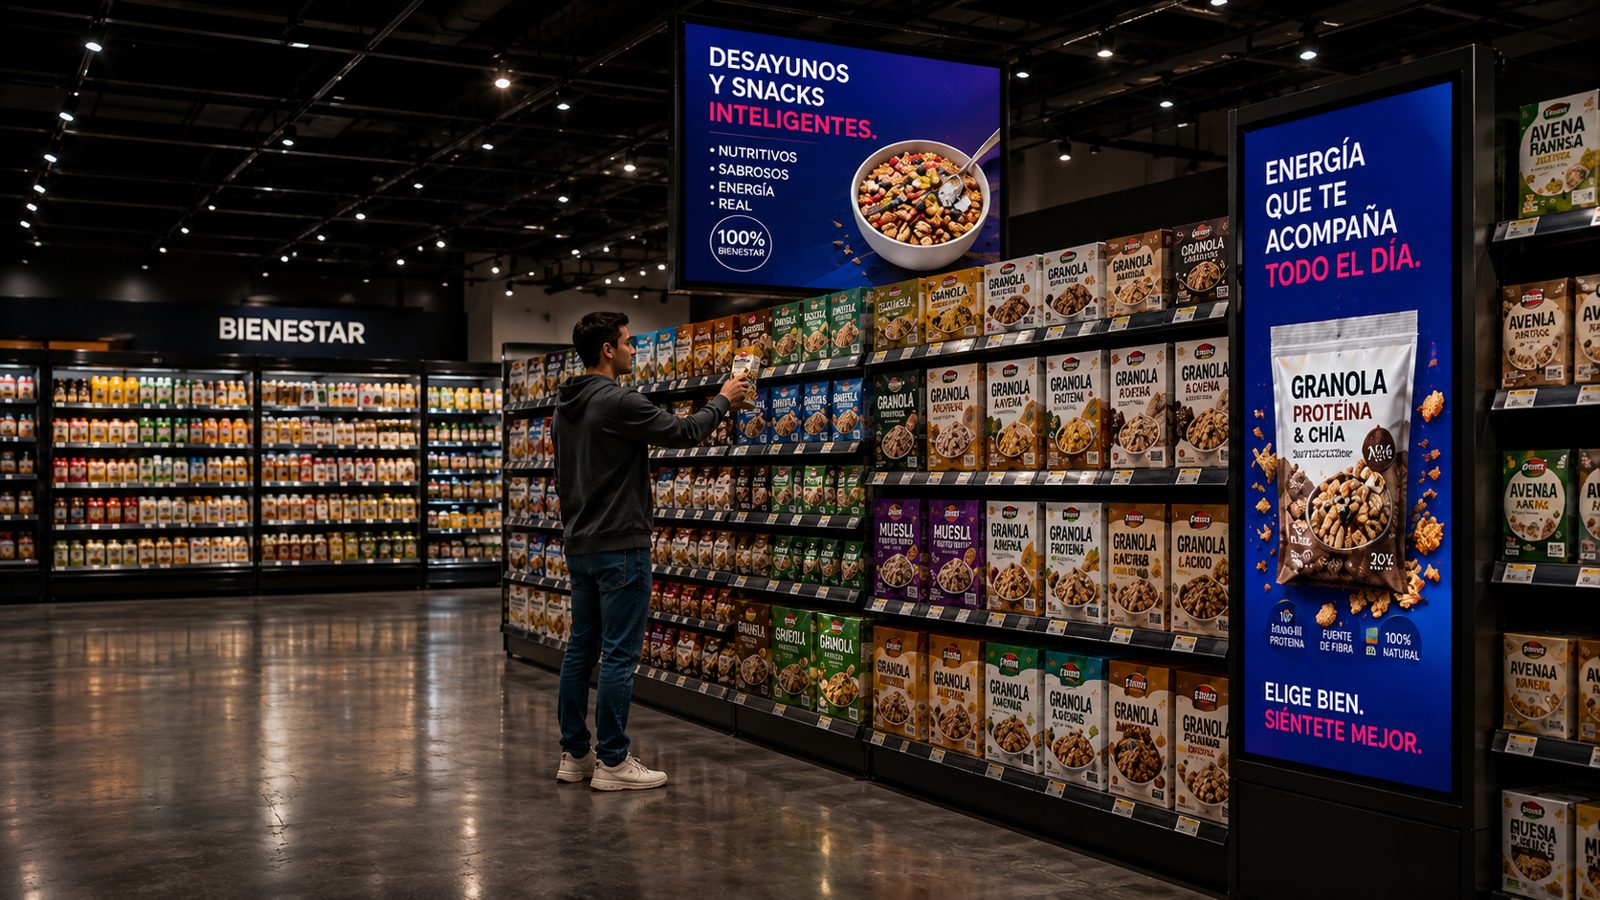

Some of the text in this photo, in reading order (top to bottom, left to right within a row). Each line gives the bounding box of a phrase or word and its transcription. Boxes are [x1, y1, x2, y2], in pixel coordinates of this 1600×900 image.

[709, 46, 850, 84] DESAYUNOS
[709, 74, 825, 107] Y SNACKS
[709, 101, 878, 140] INTELIGENTES.
[1529, 116, 1585, 144] AVENA
[718, 145, 798, 163] NUTRITIVOS
[1265, 137, 1366, 185] ENERGÍA
[718, 163, 790, 181] SABROSOS
[718, 181, 775, 197] ENERGÍA
[718, 197, 753, 211] REAL
[1265, 181, 1347, 220] QUE TE
[717, 230, 766, 248] 100%
[1265, 204, 1398, 254] ACOMPAÑA
[717, 247, 766, 258] BIENESTAR
[1265, 237, 1421, 288] TODO EL DÍA.
[1048, 262, 1088, 280] GRANOLA
[1112, 254, 1153, 273] GRANOLA
[219, 316, 366, 345] BIENESTAR
[1115, 368, 1158, 387] GRANOLA
[1182, 362, 1230, 382] GRANOLA
[991, 379, 1031, 398] GRANOLA
[1050, 373, 1092, 392] GRANOLA
[1291, 368, 1388, 400] GRANOLA
[930, 385, 970, 404] GRANOLA
[1294, 422, 1346, 443] & CHÍA
[991, 522, 1029, 539] GRANOLA
[1049, 525, 1093, 543] GRANOLA
[1113, 532, 1157, 552] GRANOLA
[1177, 535, 1227, 556] GRANOLA
[1322, 629, 1352, 642] FUENTE
[1385, 632, 1412, 646] 100%
[1319, 641, 1354, 655] DE FIBRA
[1383, 647, 1421, 661] NATURAL
[990, 679, 1030, 701] GRANOLA
[1265, 681, 1364, 716] ELIGE BIEN.
[1050, 690, 1092, 715] GRANOLA
[1114, 701, 1159, 727] GRANOLA
[1265, 706, 1423, 755] SIÉNTETE MEJOR.
